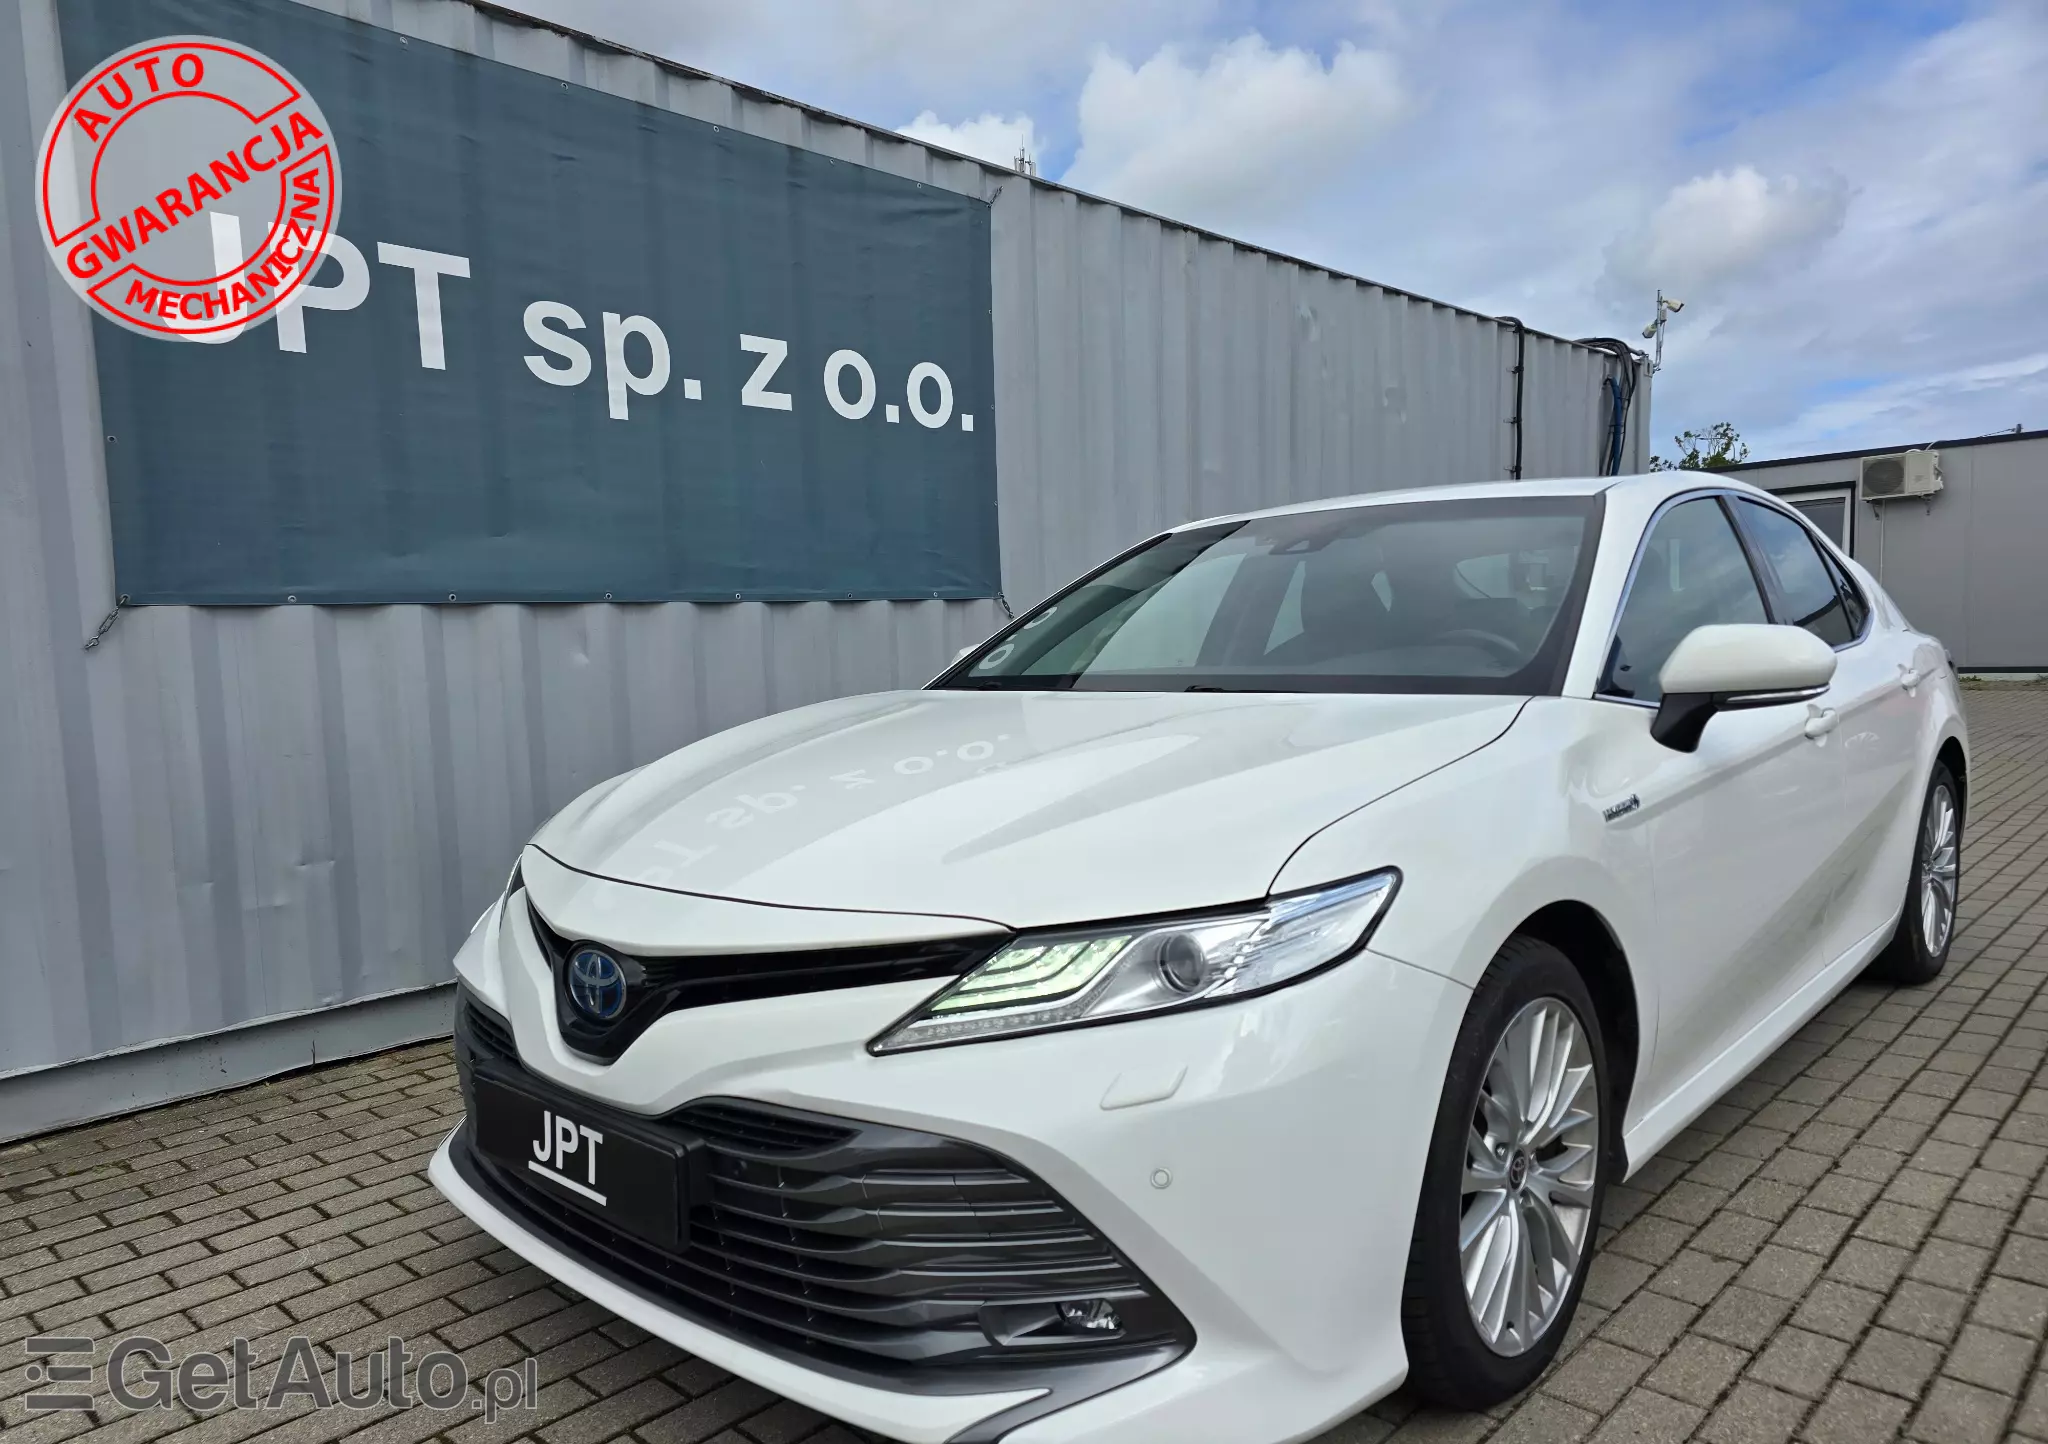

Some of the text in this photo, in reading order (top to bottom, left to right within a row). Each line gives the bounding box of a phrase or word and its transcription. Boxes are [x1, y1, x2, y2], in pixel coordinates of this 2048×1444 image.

[156, 211, 974, 431] JPT sp. z o.o.
[532, 1109, 604, 1186] JPT
